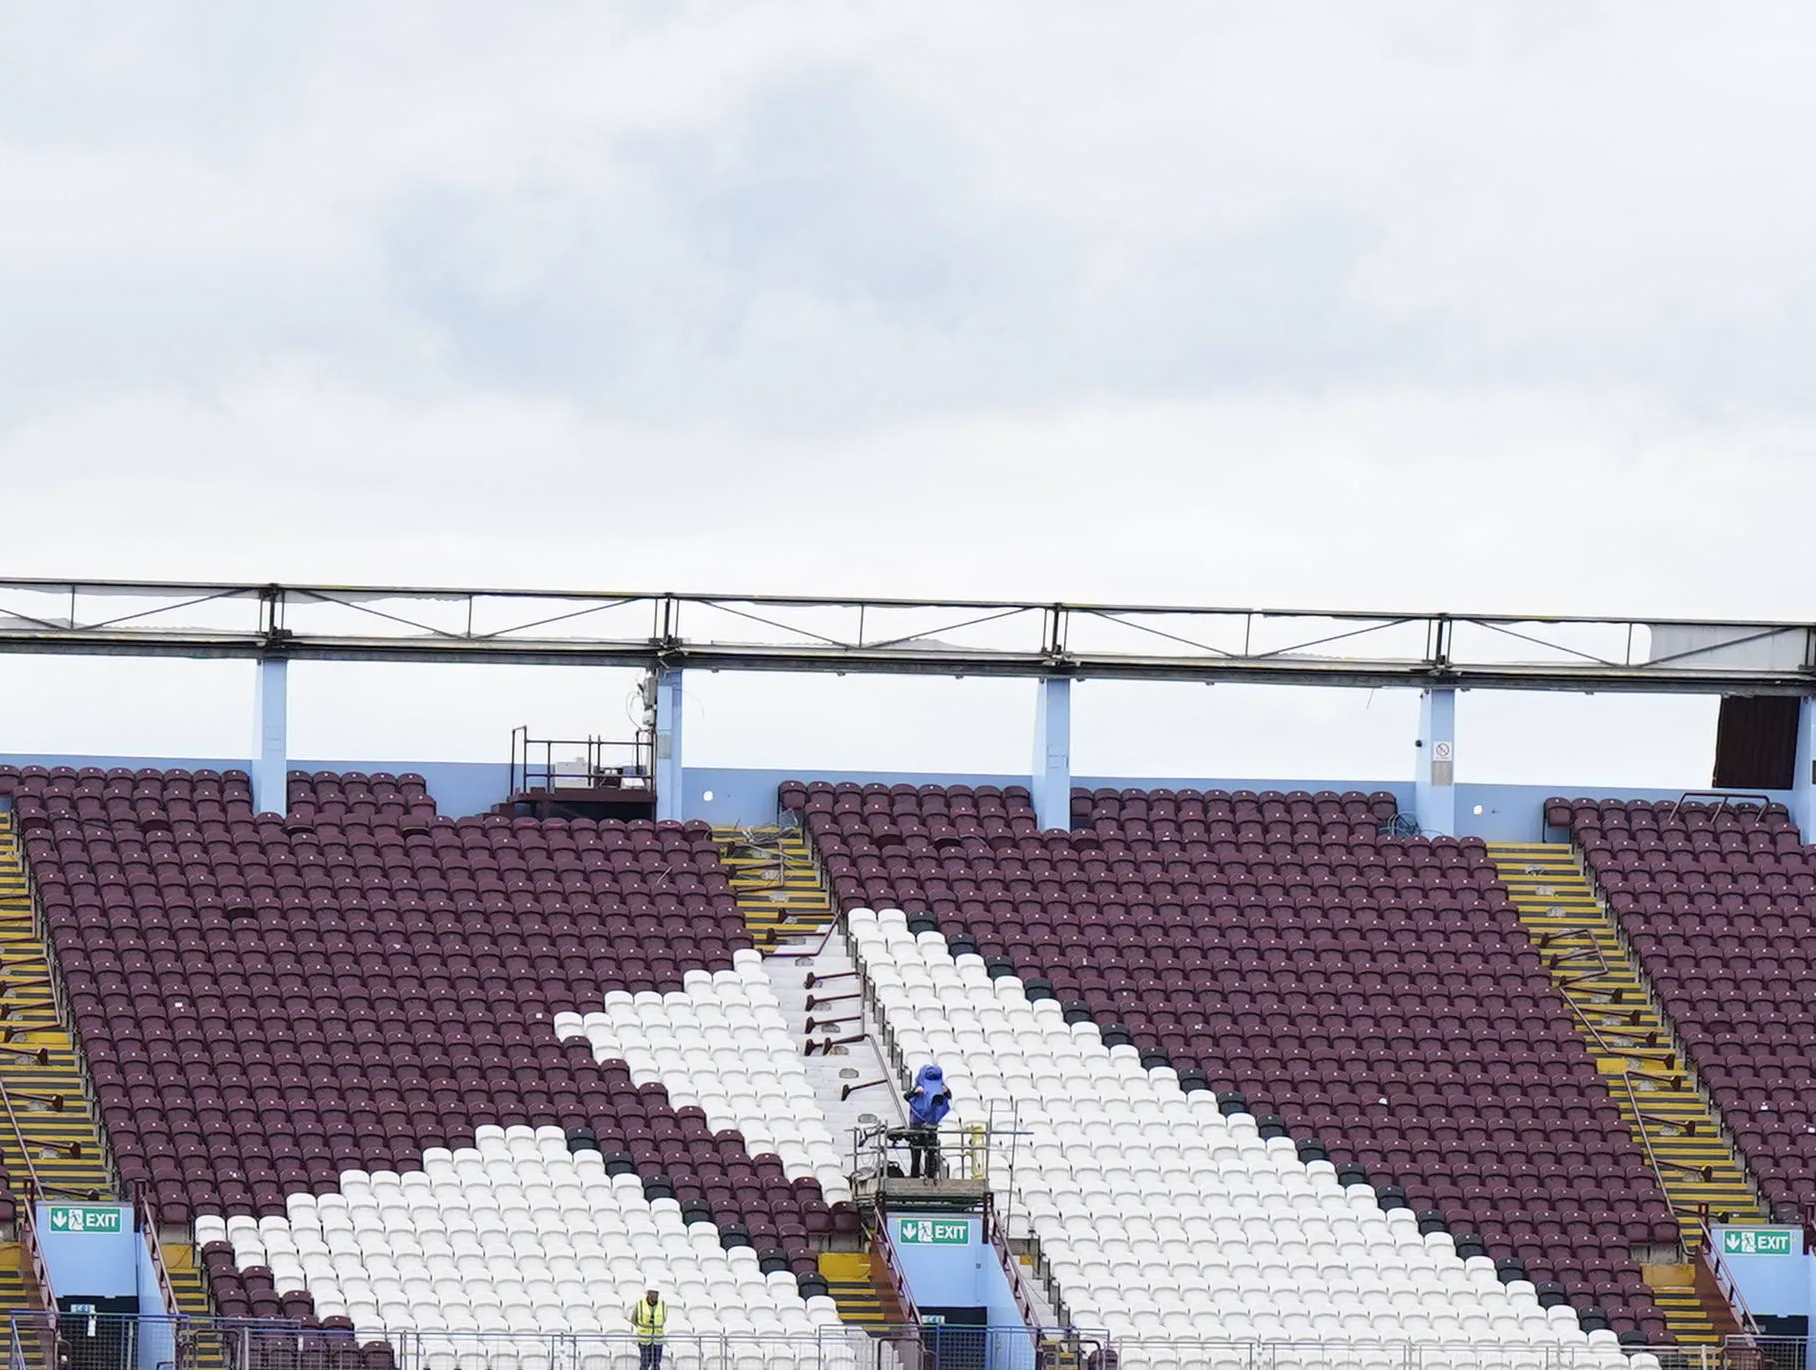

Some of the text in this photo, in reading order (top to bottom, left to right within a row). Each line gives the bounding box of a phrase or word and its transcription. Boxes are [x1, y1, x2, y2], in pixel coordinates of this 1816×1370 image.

[86, 1213, 118, 1227] EXIT
[935, 1225, 967, 1239] EXIT
[1757, 1236, 1788, 1249] EXIT
